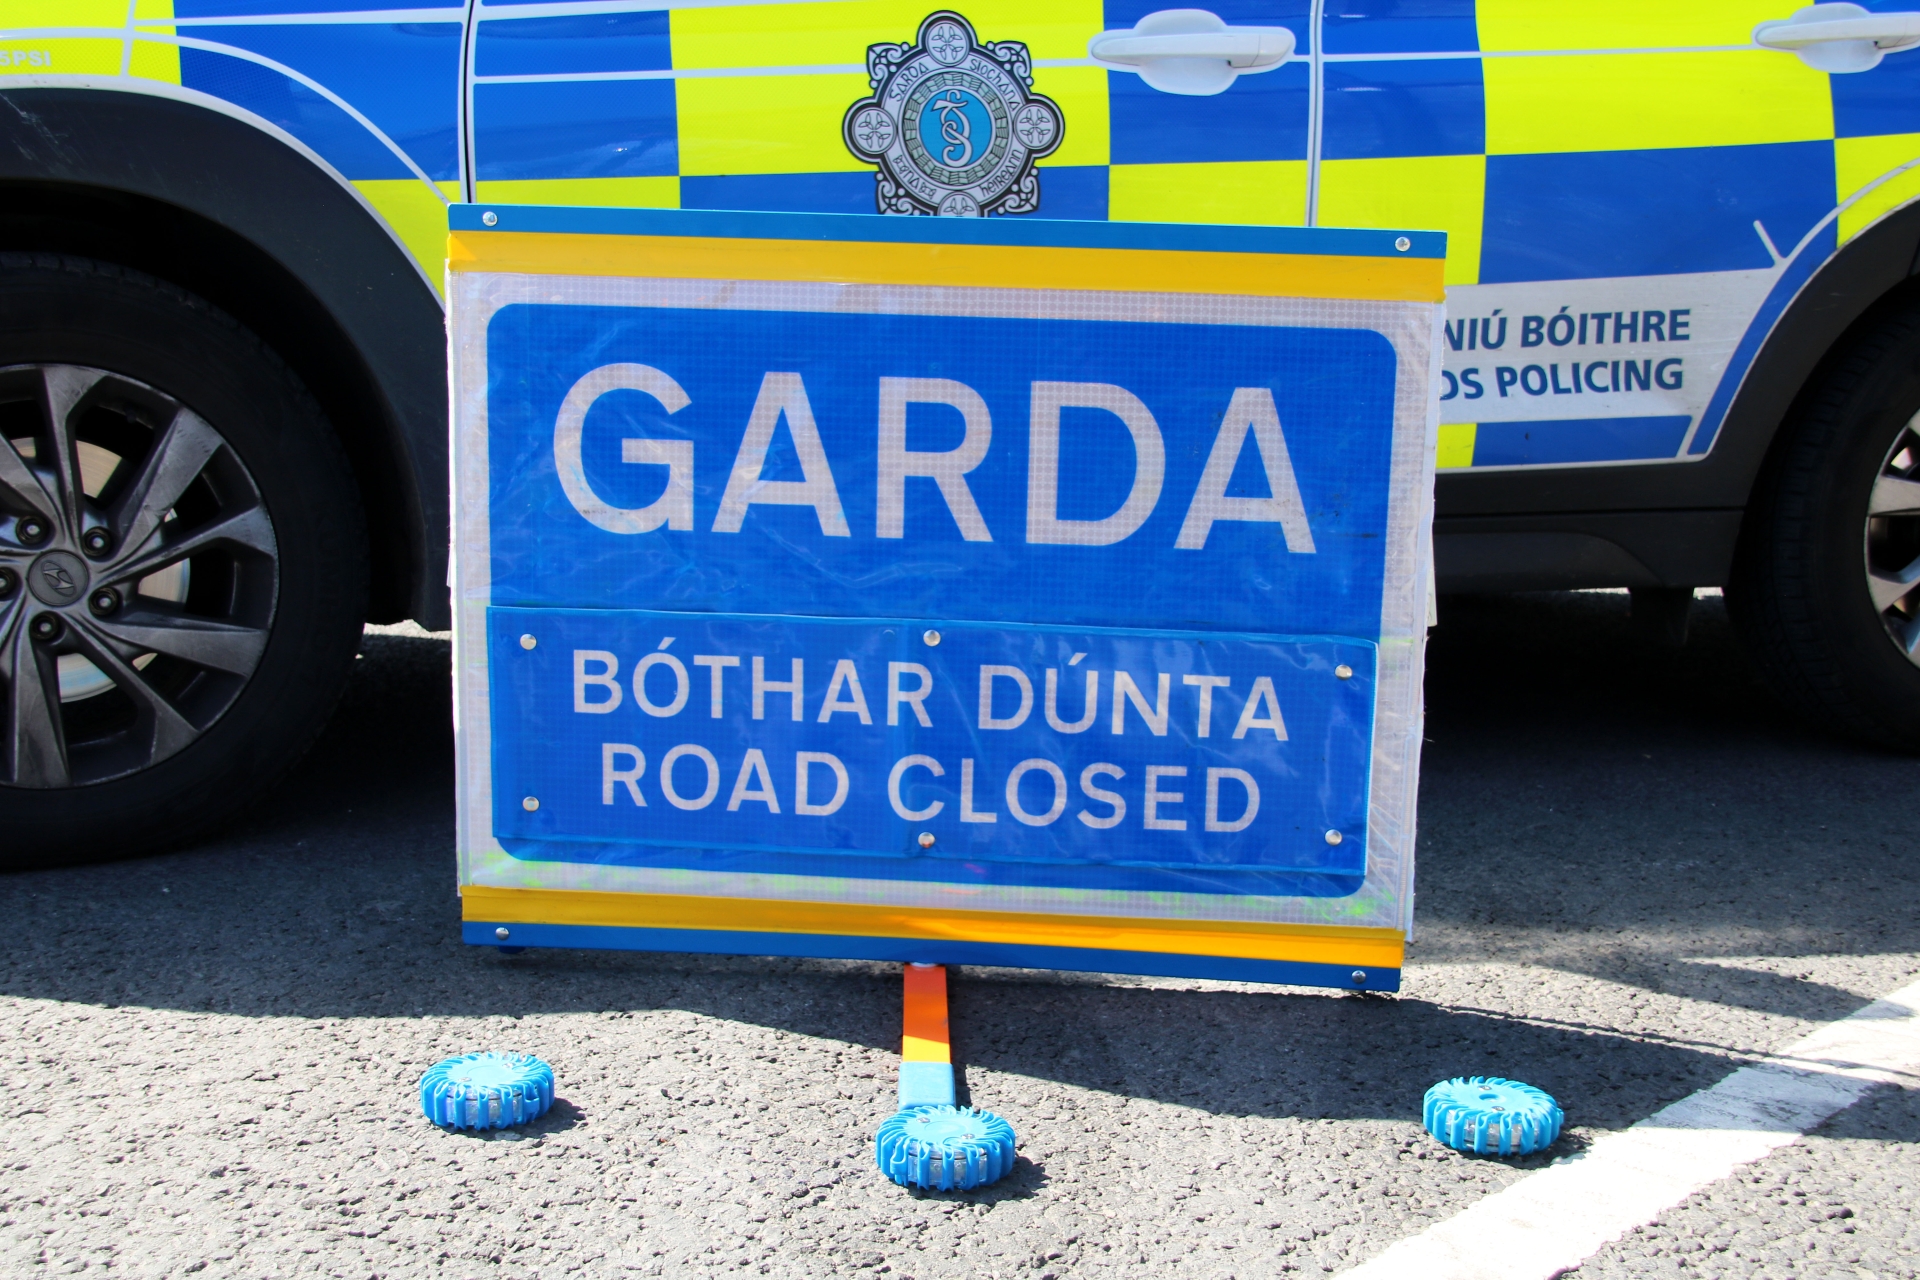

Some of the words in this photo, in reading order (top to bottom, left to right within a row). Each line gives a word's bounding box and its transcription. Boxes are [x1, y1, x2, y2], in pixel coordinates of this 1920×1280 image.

[1520, 306, 1691, 348] BÓITHRE
[1495, 357, 1684, 398] POLICING
[553, 362, 1317, 554] GARDA
[573, 636, 933, 728] BÓTHAR
[978, 652, 1290, 742] DÚNTA
[602, 743, 850, 816] ROAD
[887, 754, 1261, 833] CLOSED
